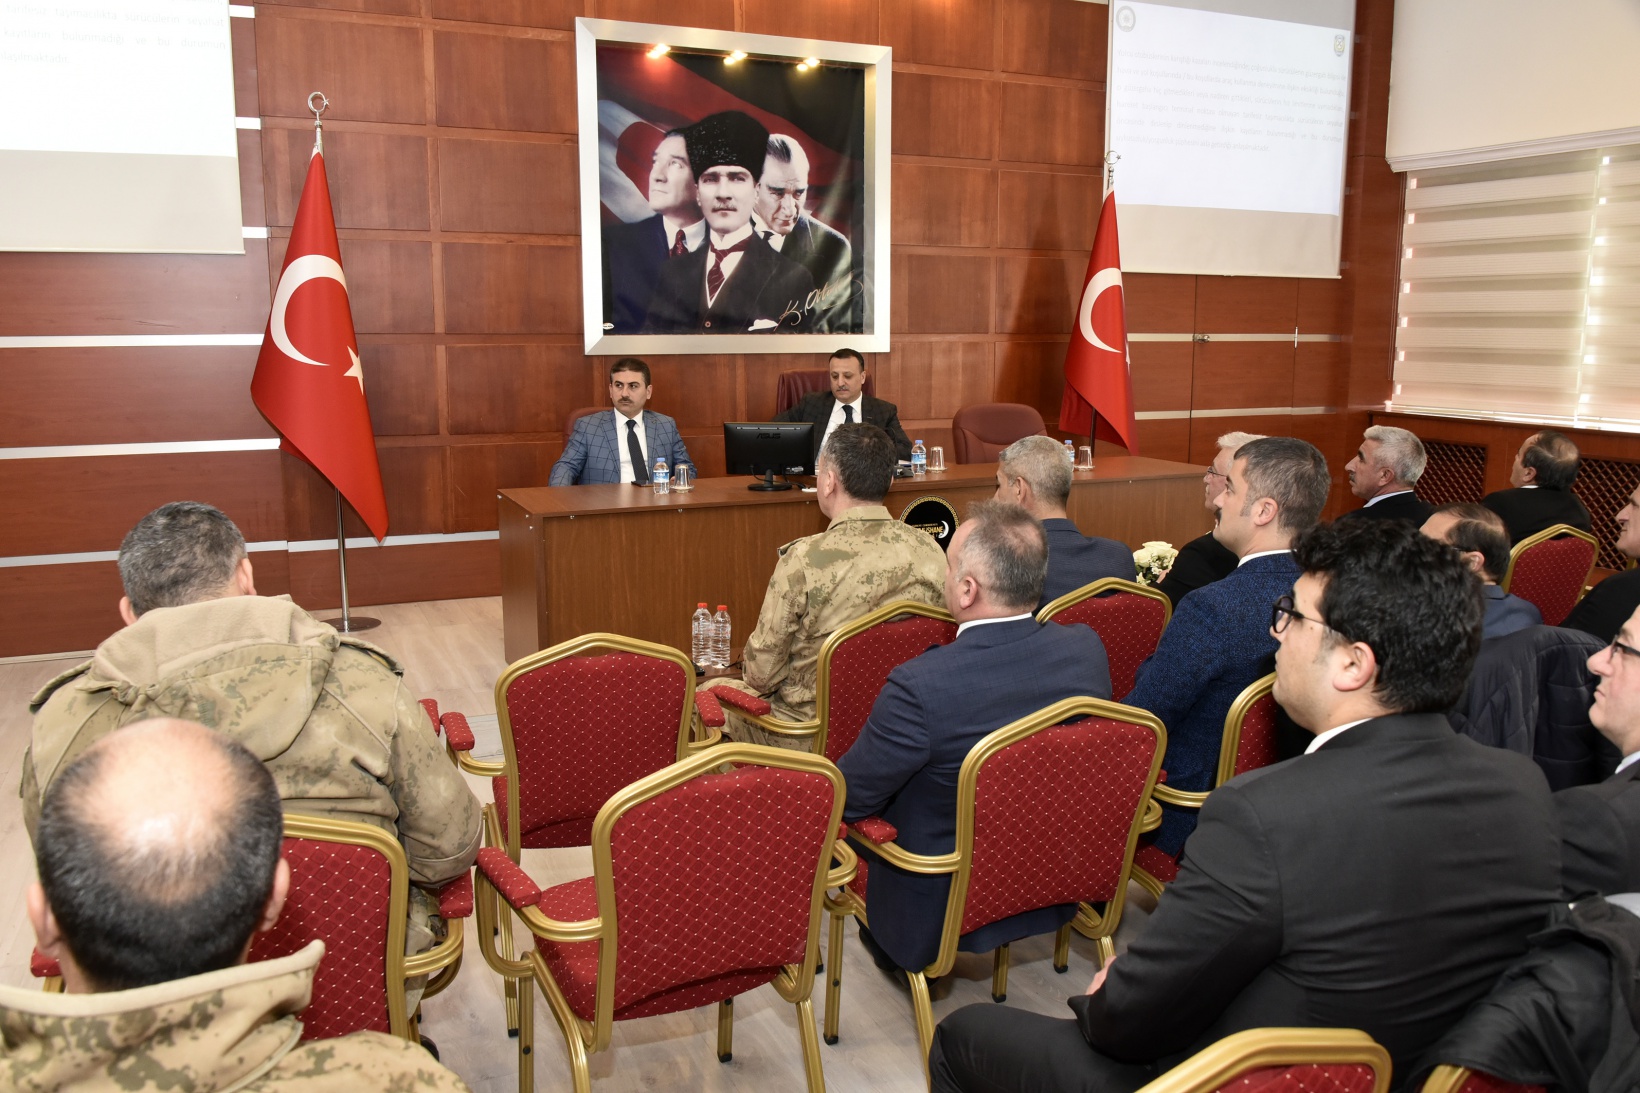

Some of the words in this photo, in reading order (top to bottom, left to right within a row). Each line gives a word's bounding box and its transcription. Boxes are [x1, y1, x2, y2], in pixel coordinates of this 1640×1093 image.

[135, 37, 148, 45] ve
[157, 36, 170, 46] bu
[181, 38, 226, 50] durumun
[756, 432, 782, 440] ASUS
